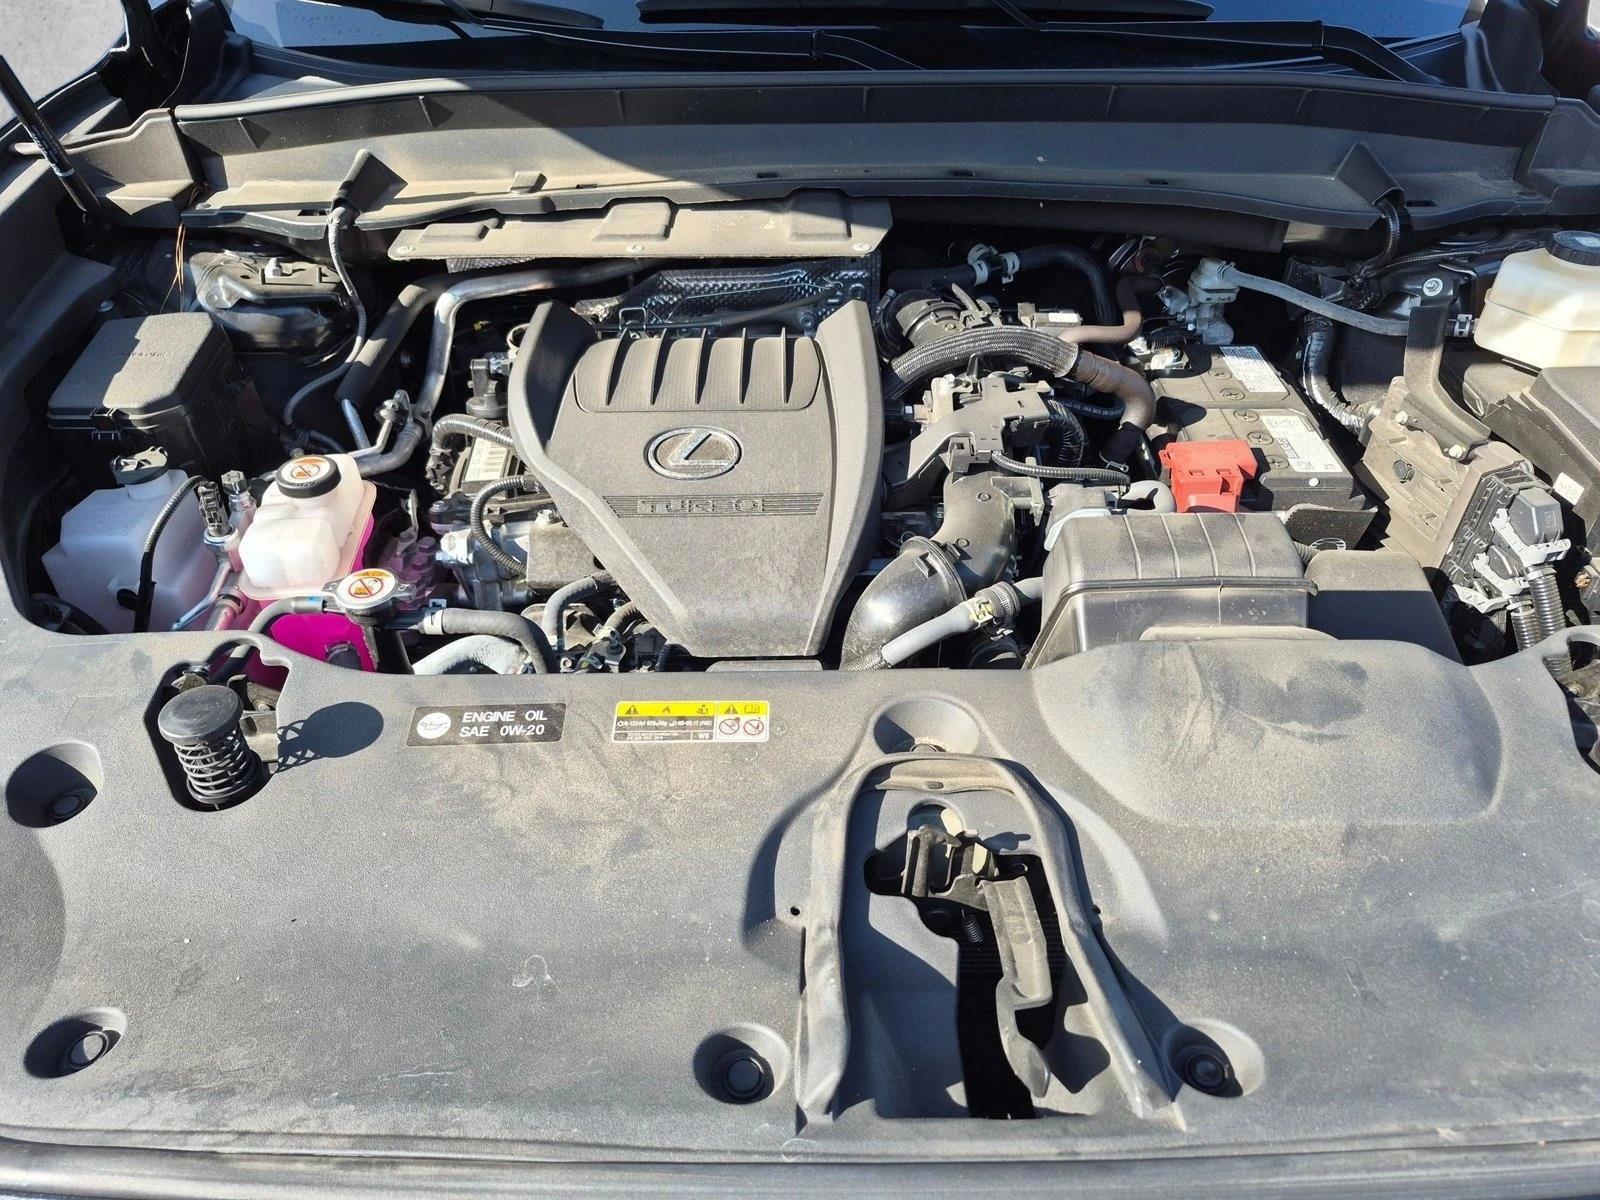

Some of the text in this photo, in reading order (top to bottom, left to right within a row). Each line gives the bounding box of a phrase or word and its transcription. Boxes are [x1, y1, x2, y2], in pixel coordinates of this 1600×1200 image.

[640, 498, 760, 514] TURBO
[462, 710, 548, 723] ENGINE OIL
[459, 724, 545, 738] SAE 0W-20
